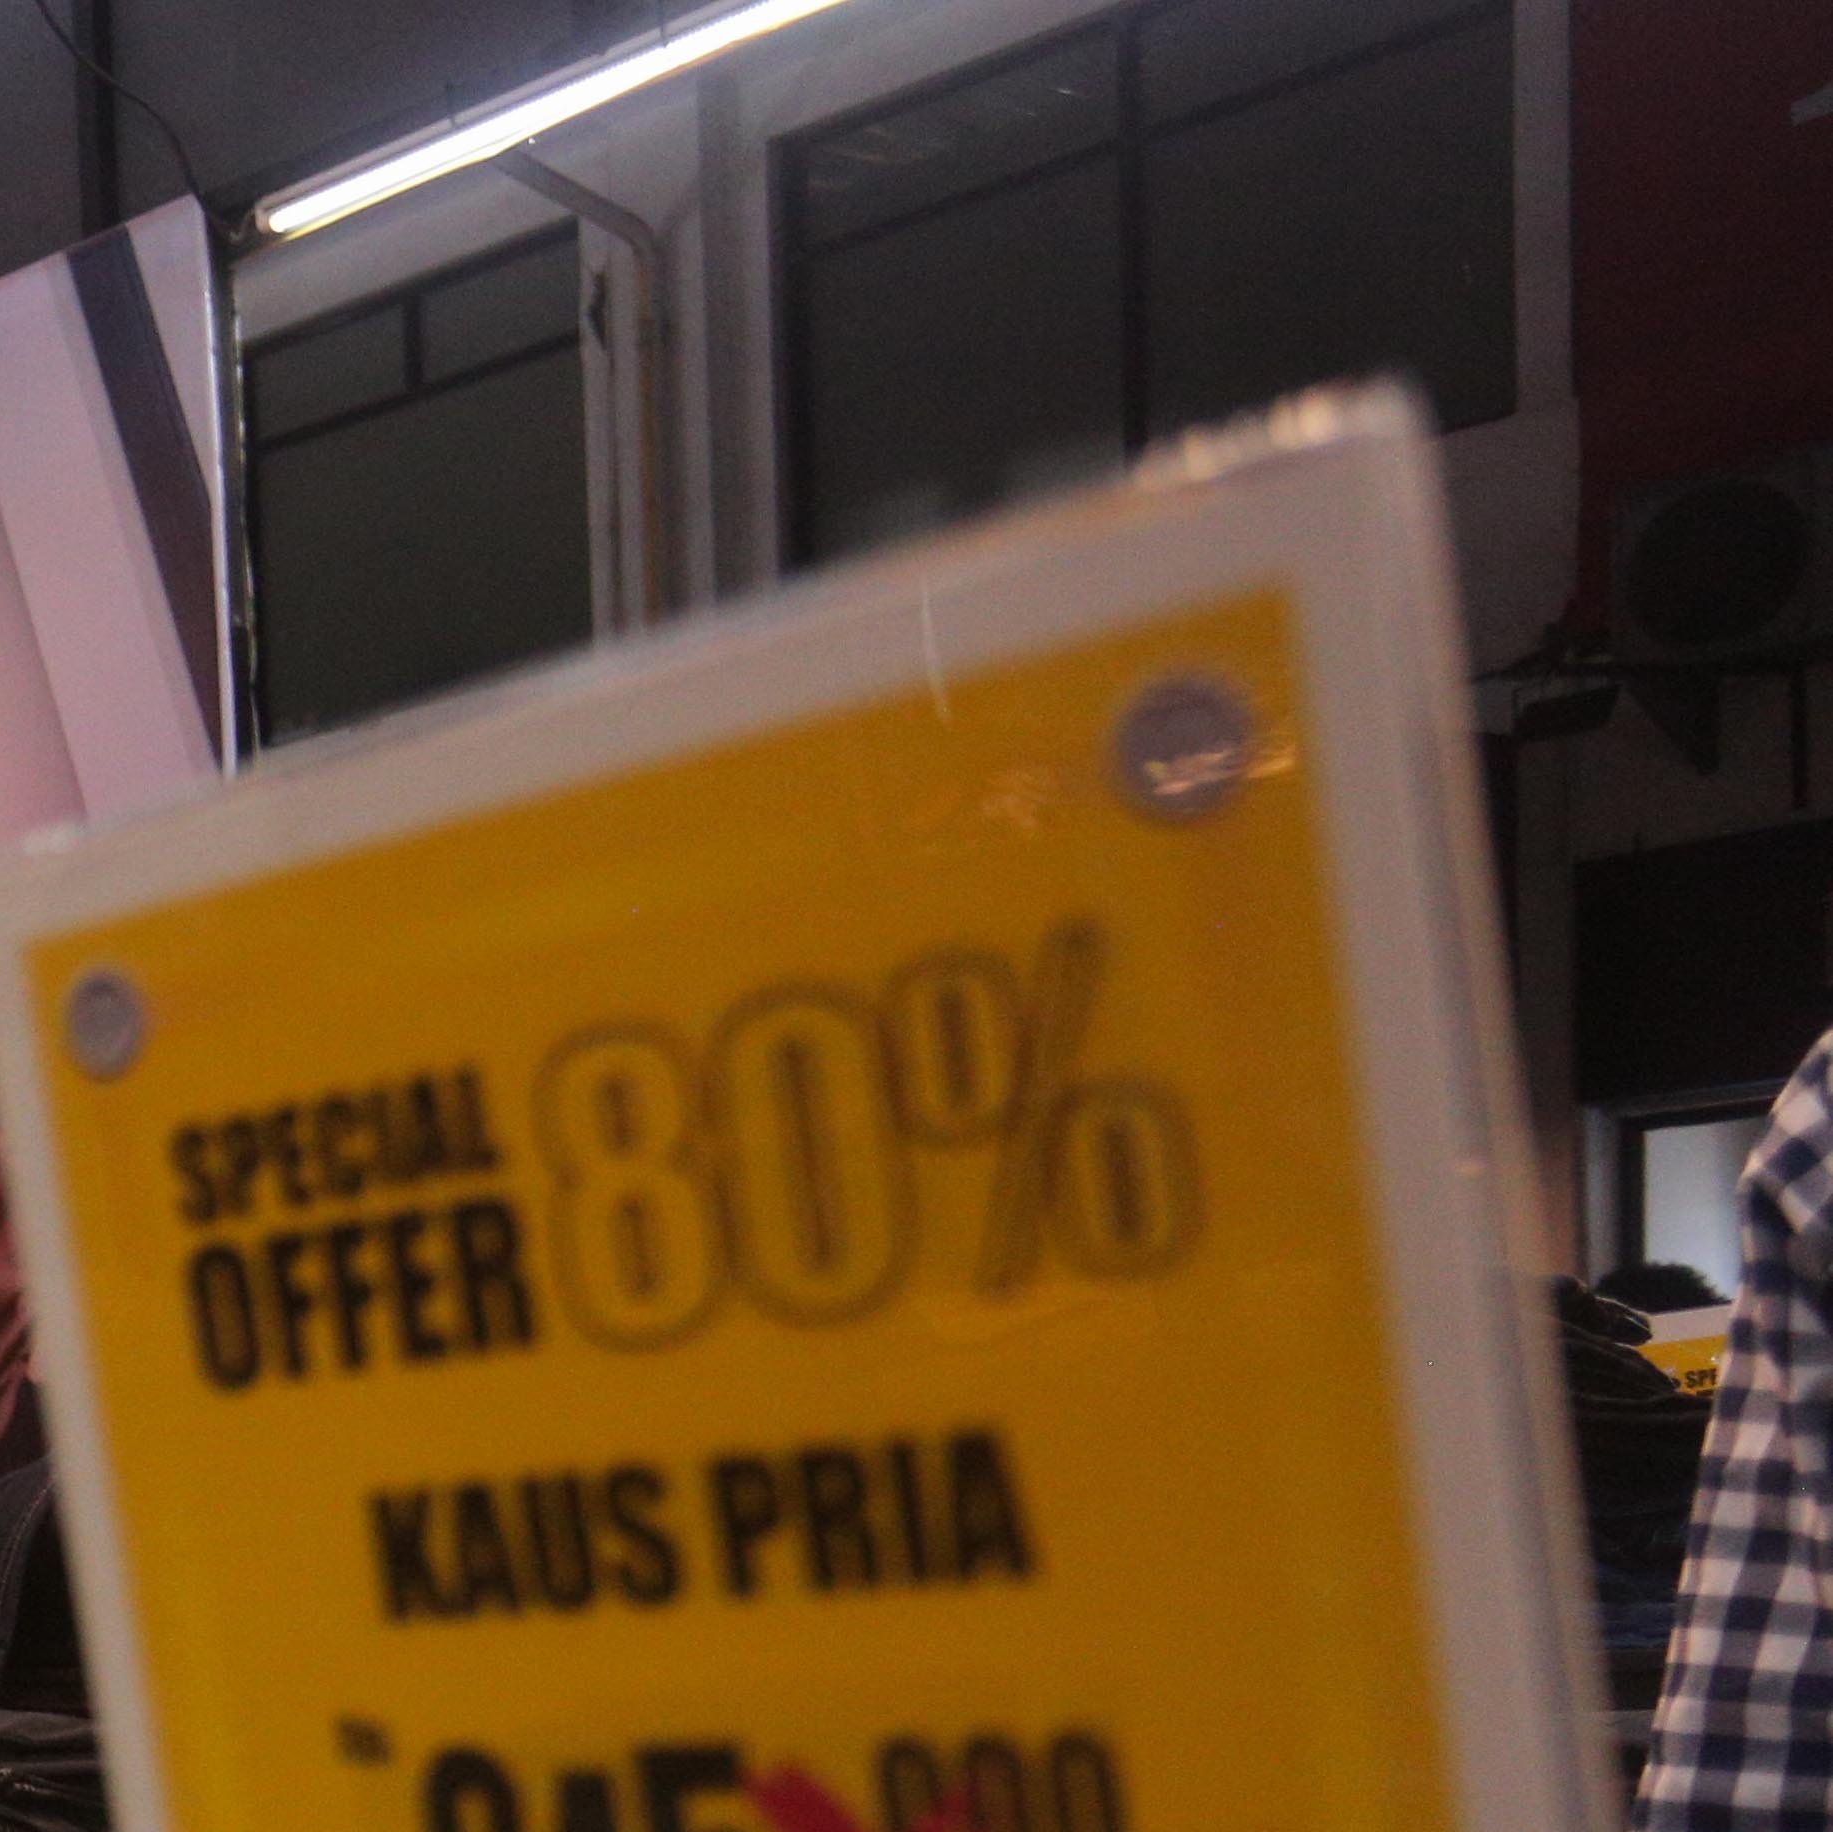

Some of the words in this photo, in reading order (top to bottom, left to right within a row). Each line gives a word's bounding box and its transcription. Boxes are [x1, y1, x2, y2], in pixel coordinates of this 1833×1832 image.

[170, 1060, 504, 1226] SPECIAL
[531, 915, 1210, 1356] 80%
[187, 1196, 542, 1391] OFFER
[367, 1458, 682, 1630] KAUS
[708, 1420, 1037, 1599] PRIA
